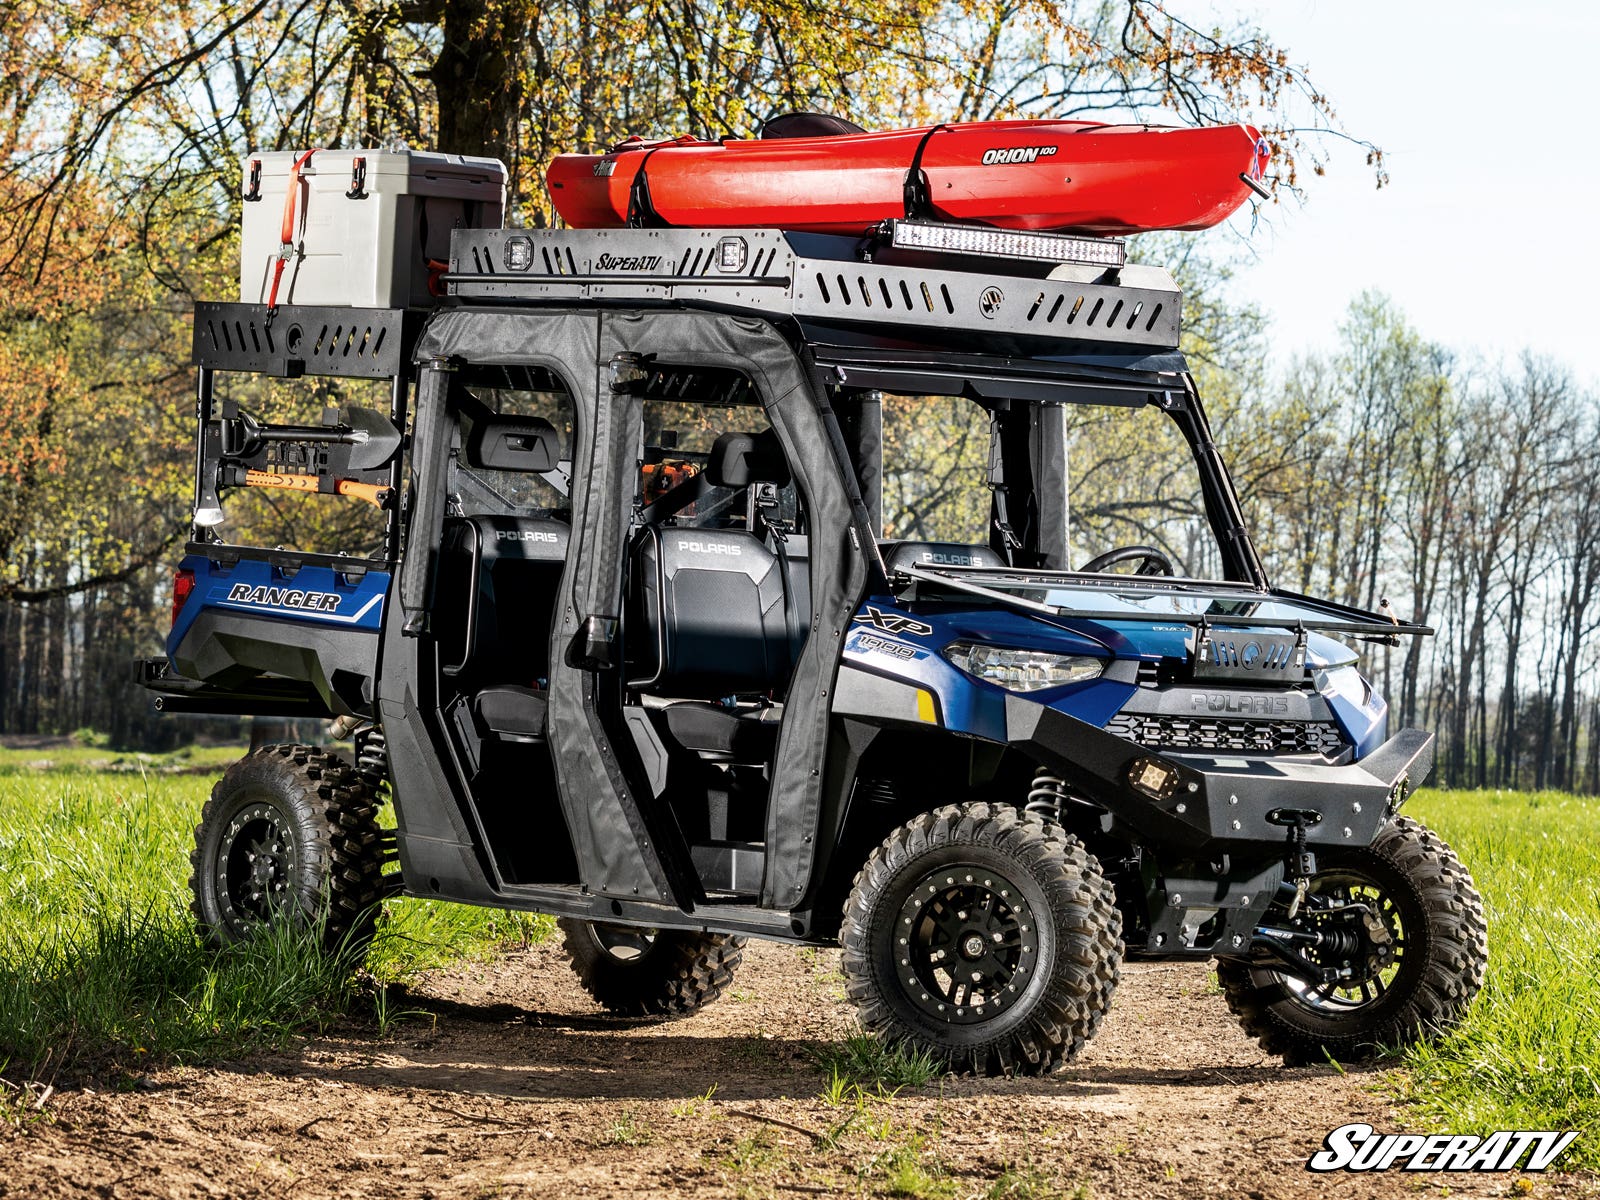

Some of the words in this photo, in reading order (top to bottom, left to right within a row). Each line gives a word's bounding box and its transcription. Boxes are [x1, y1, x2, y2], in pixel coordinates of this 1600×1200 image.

[982, 147, 1040, 165] ORION
[1038, 145, 1058, 156] 100
[495, 530, 559, 543] POLARIS
[677, 541, 742, 556] POLARIS
[922, 552, 983, 568] POLARIS
[227, 582, 342, 612] RANGER
[852, 605, 933, 636] XP
[860, 634, 917, 660] 1000
[1191, 693, 1288, 714] POLARIS
